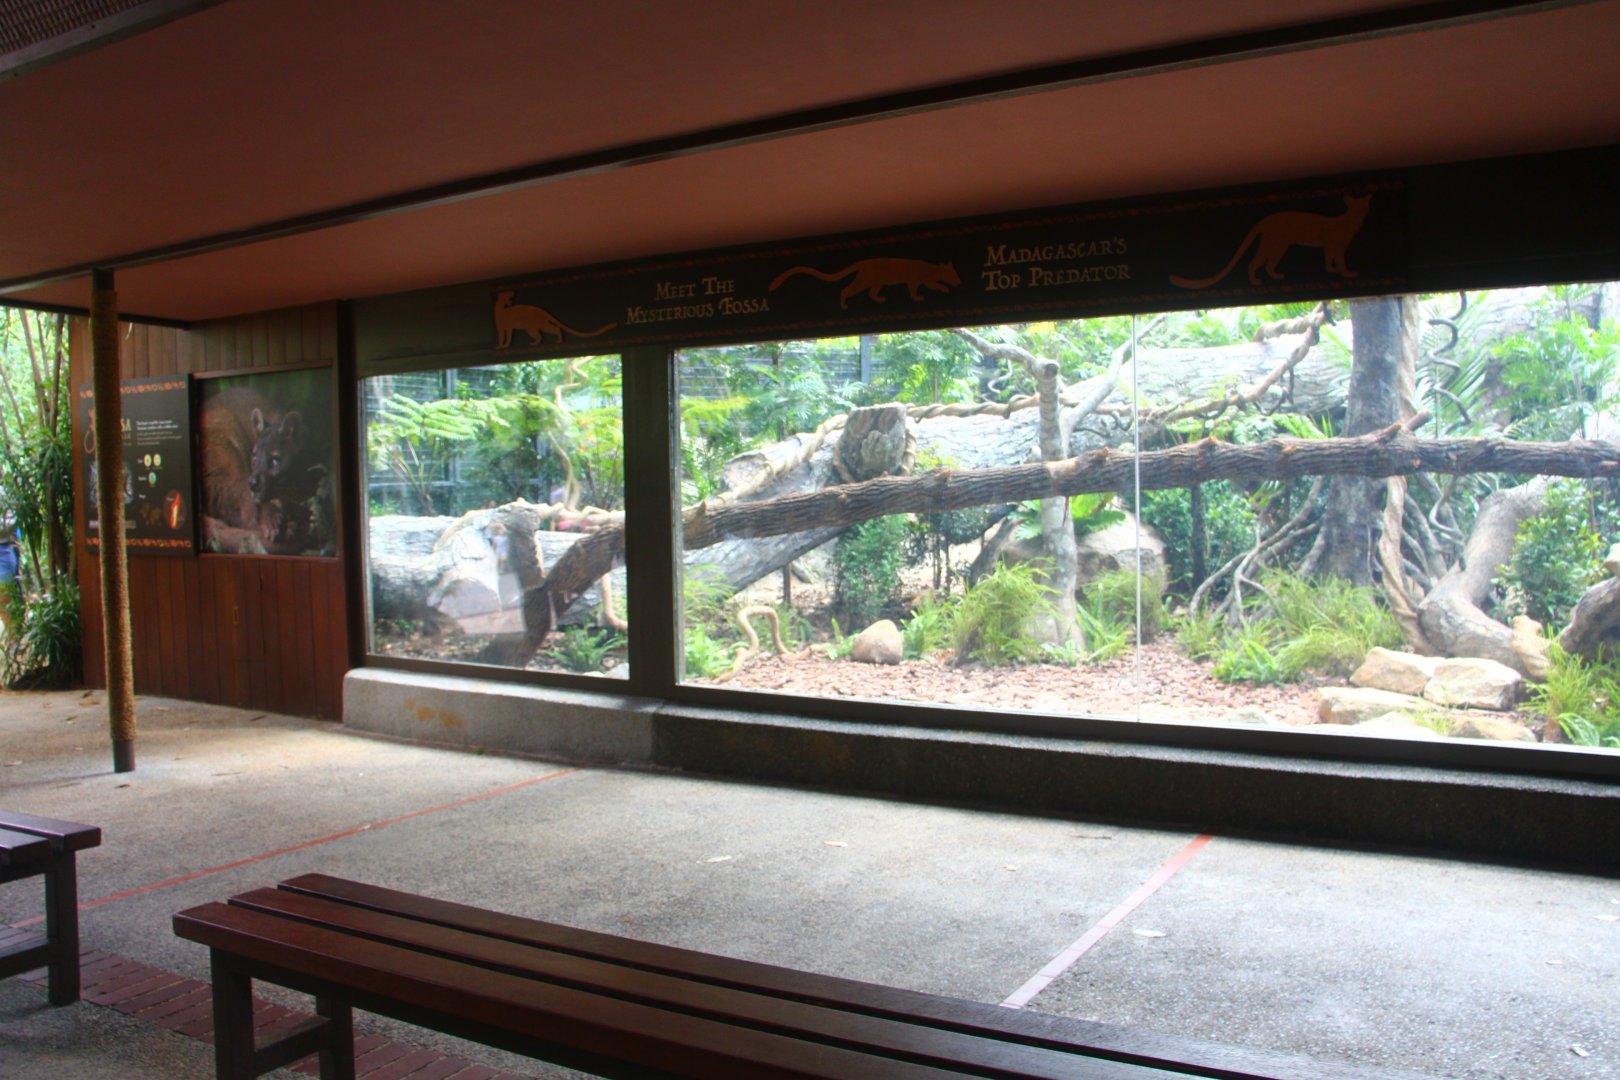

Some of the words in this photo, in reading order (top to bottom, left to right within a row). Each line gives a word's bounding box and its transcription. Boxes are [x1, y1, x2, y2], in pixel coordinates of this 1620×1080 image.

[983, 235, 1128, 267] MADAGASCAR'S
[654, 281, 696, 301] MEET
[701, 275, 736, 296] THE
[981, 269, 1021, 291] TOP
[1028, 264, 1131, 287] PREDATOR
[625, 303, 714, 325] MYSTERIOUS
[718, 295, 770, 316] FOSSA
